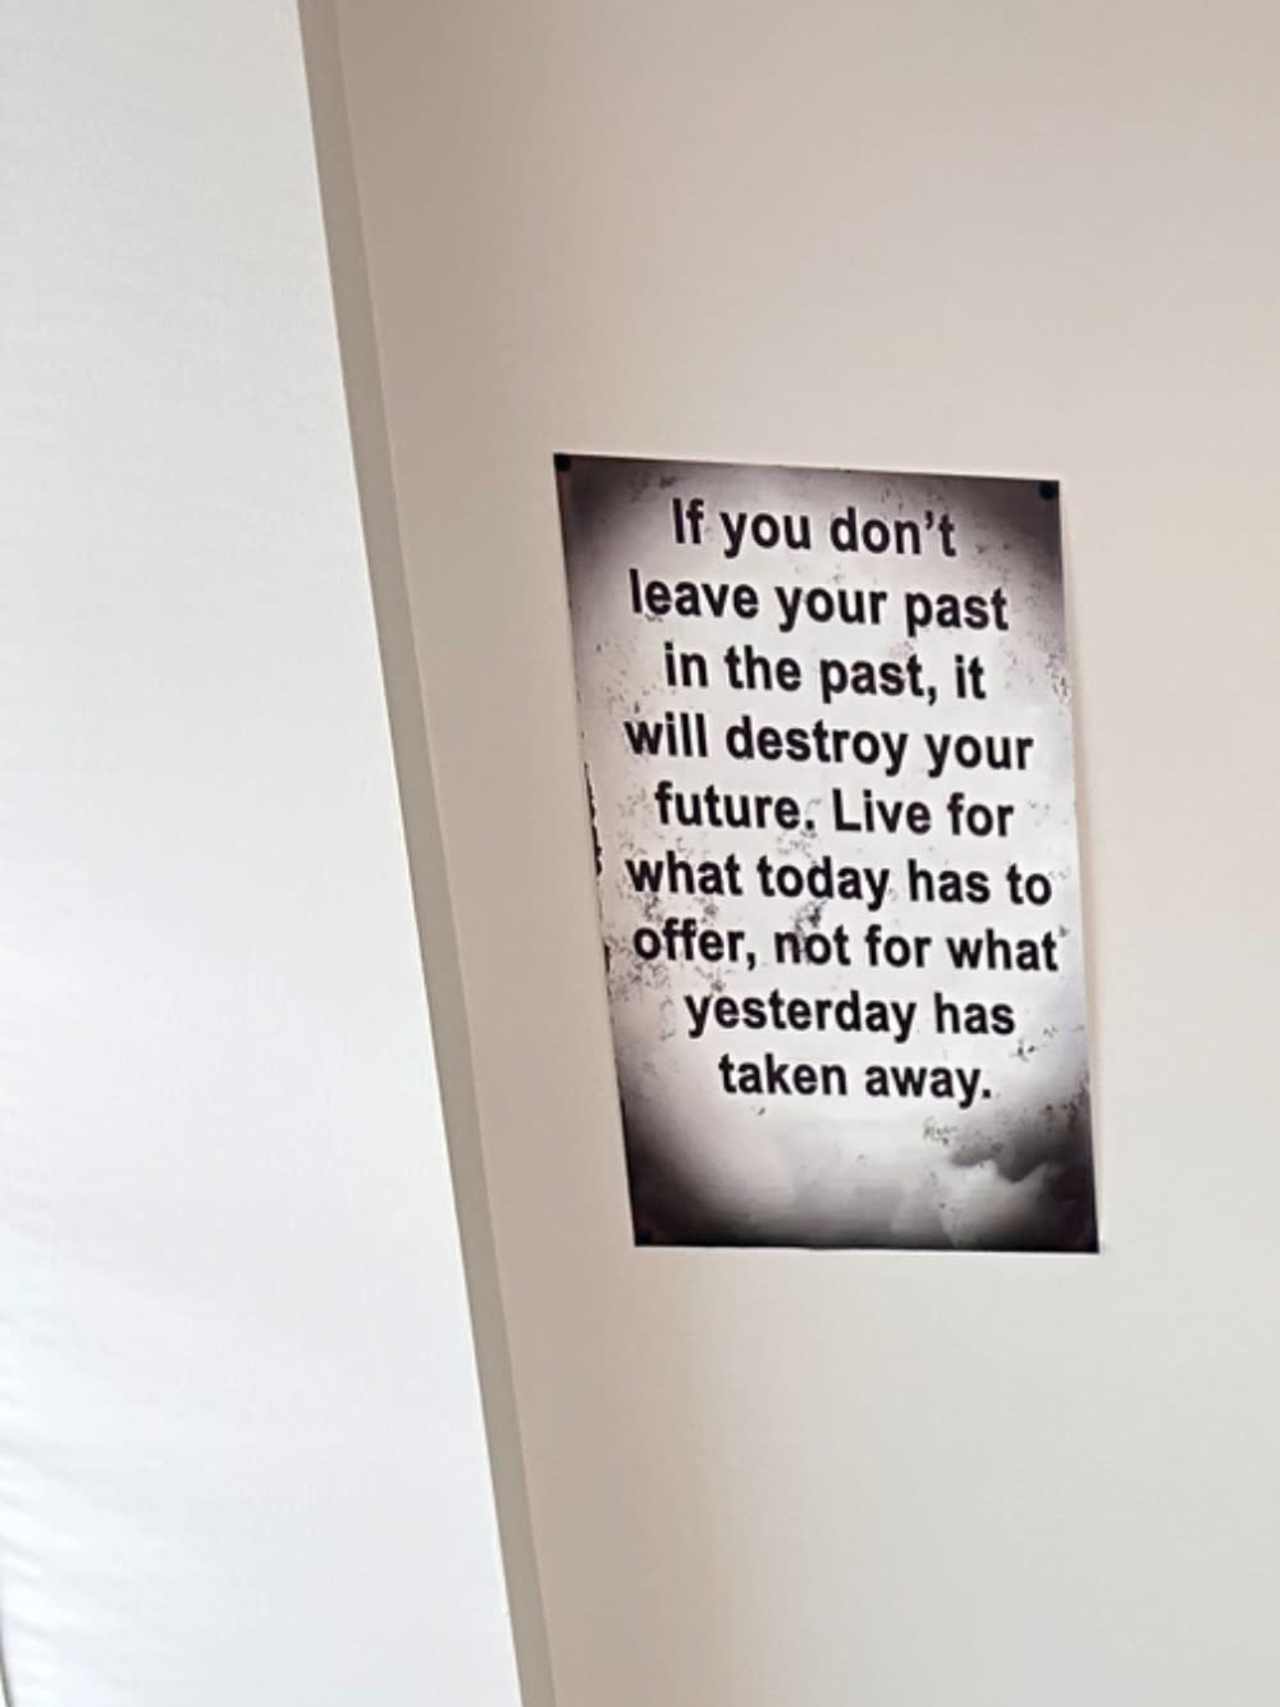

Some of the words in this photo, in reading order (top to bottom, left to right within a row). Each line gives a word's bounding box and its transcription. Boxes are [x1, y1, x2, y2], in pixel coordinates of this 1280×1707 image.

[672, 498, 705, 546] If
[719, 505, 811, 560] you
[830, 507, 956, 558] don't
[629, 569, 759, 619] leave
[774, 584, 887, 633] your
[905, 589, 1009, 637] past
[665, 642, 708, 690] in
[724, 645, 802, 693] the
[820, 657, 938, 705] past,
[954, 653, 985, 701] it
[625, 714, 708, 759] will
[726, 715, 910, 776] destroy
[925, 730, 1033, 778] your
[653, 781, 817, 832] future.
[833, 789, 931, 836] Live
[947, 792, 1014, 838] for
[626, 853, 742, 898] what
[758, 856, 890, 911] today
[908, 860, 991, 906] has
[1006, 863, 1052, 906] to
[634, 919, 757, 972] offer,
[774, 925, 852, 967] not
[866, 925, 932, 969] for
[946, 928, 1059, 973] what
[684, 992, 916, 1043] yesterday
[933, 993, 1015, 1036] has
[719, 1052, 847, 1097] taken
[865, 1061, 993, 1109] away.
